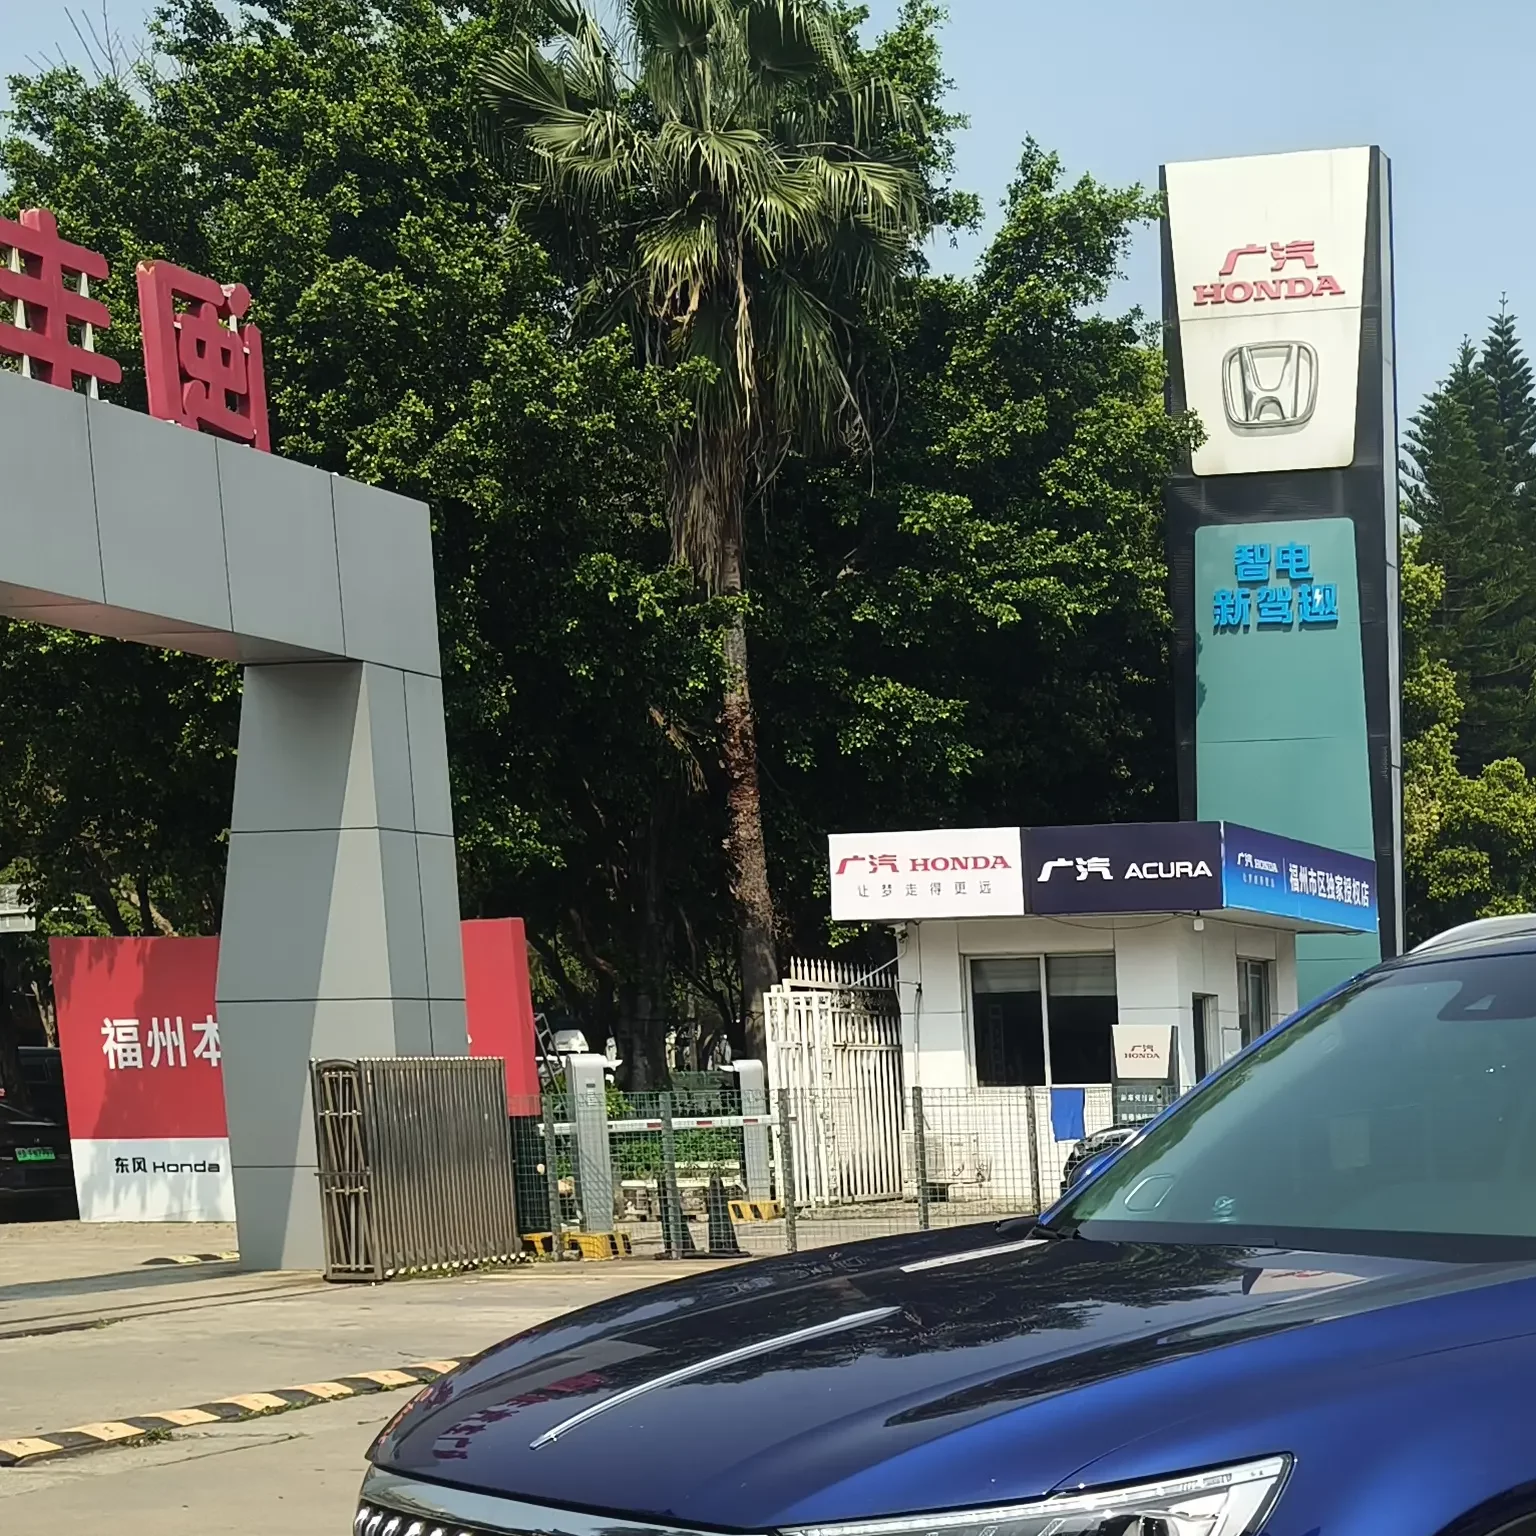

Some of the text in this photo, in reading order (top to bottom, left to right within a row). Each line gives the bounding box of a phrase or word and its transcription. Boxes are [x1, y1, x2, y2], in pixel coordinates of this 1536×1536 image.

[1219, 240, 1318, 276] 广汽
[1193, 275, 1345, 306] HONDA
[1234, 541, 1314, 583] 智电
[836, 854, 1012, 875] 广汽 HONDA
[1037, 856, 1213, 882] 广汽 ACURA
[857, 880, 992, 898] 让梦走得更远
[1289, 862, 1370, 908] 福州市区独家授权店
[114, 1157, 220, 1173] 东风 Honda
